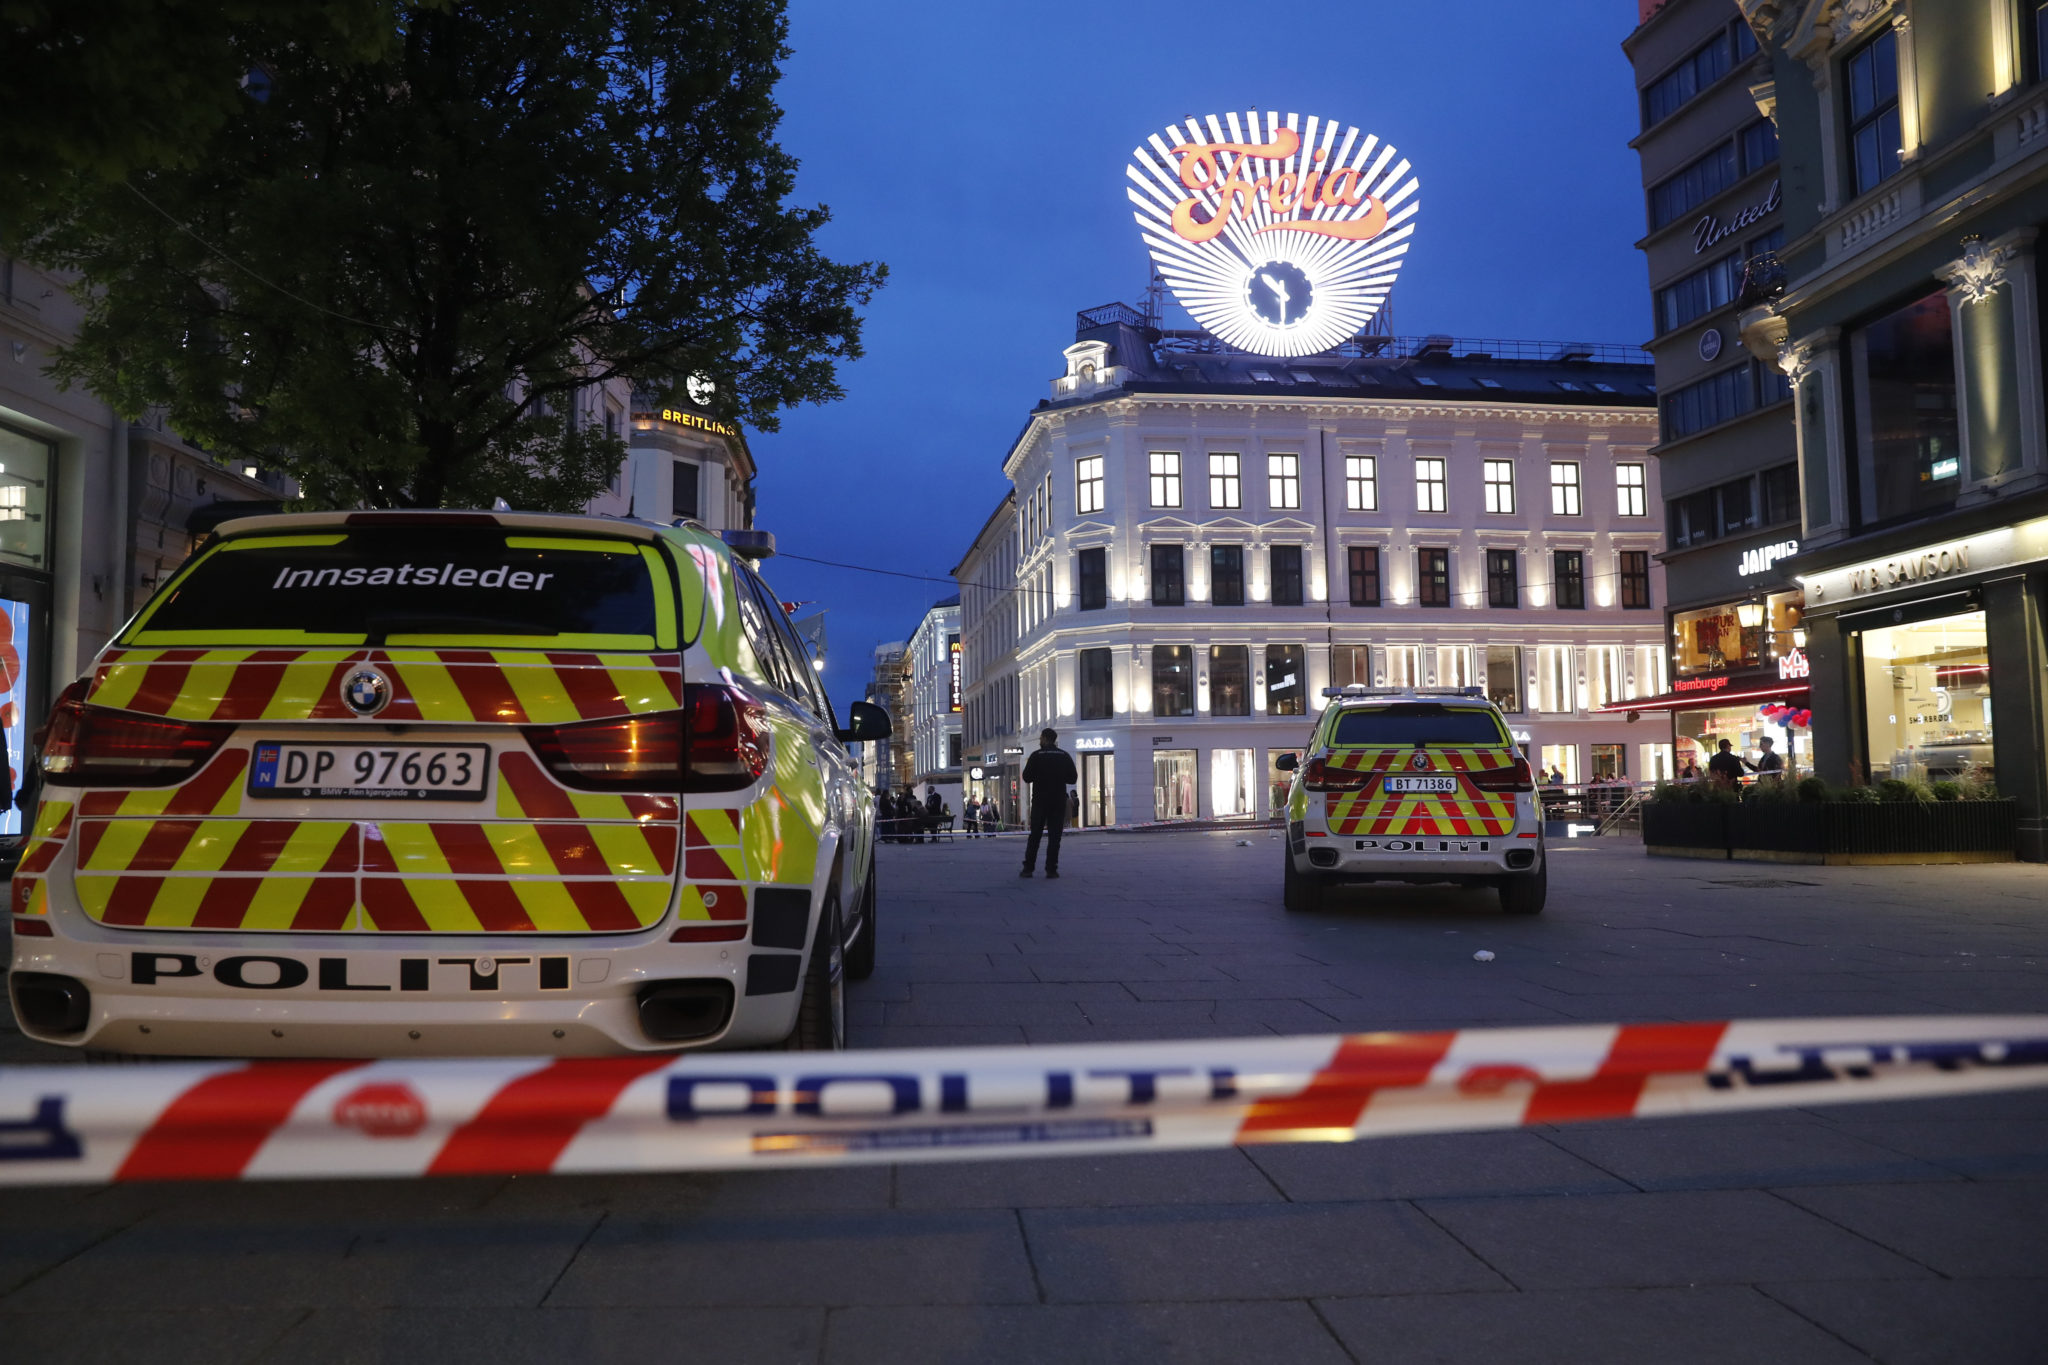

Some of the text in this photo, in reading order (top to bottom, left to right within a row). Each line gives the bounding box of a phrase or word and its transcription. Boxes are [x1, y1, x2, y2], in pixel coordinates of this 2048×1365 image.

[1168, 127, 1388, 244] Freia
[1692, 179, 1780, 254] United
[1887, 545, 1970, 585] SAMSON
[273, 563, 554, 591] Innsatsleder
[1674, 677, 1729, 692] Hamburger
[1908, 714, 1950, 725] SMRBRØD
[1075, 737, 1115, 749] ZARA
[259, 772, 271, 783] N
[284, 750, 472, 786] DP 97663
[320, 788, 343, 796] BMW
[1396, 779, 1452, 790] BT 71386
[1355, 840, 1490, 852] POLITI
[131, 952, 570, 992] POLITI
[666, 1068, 1238, 1121] POLITI
